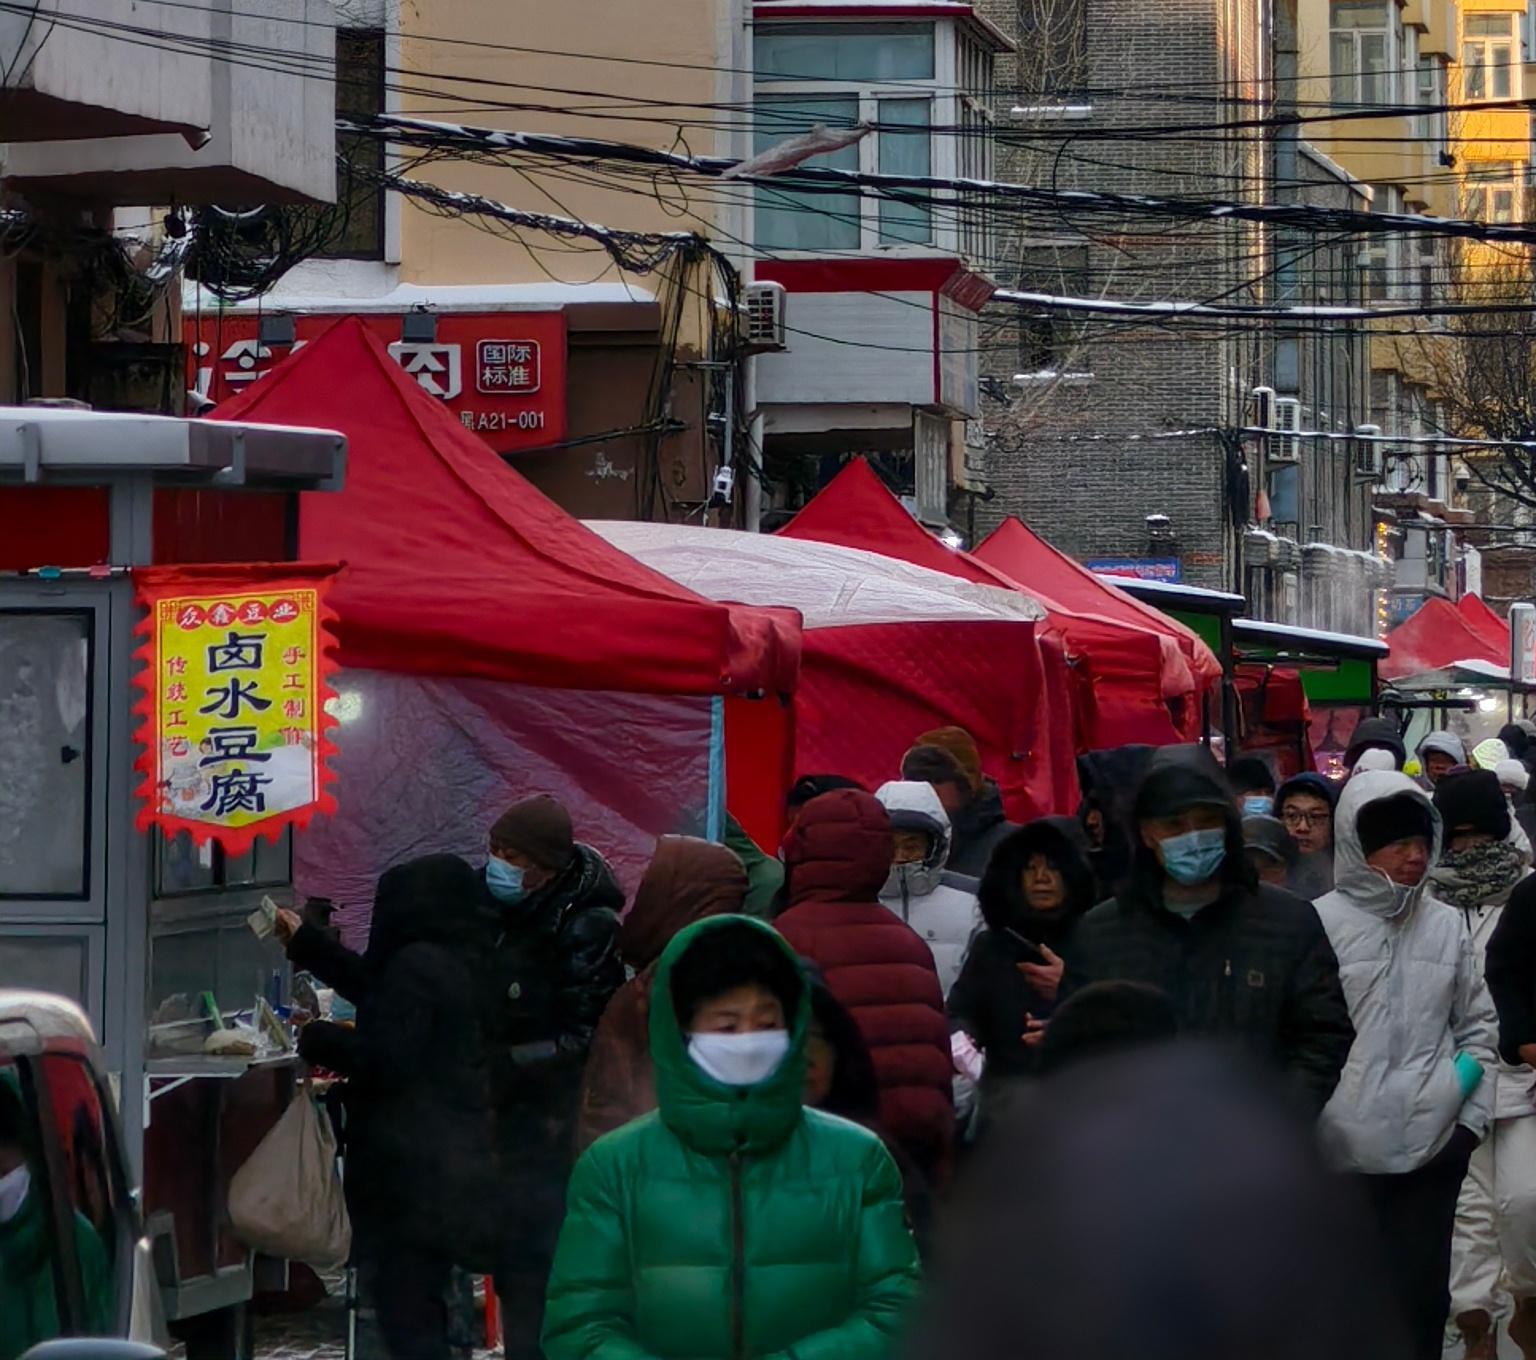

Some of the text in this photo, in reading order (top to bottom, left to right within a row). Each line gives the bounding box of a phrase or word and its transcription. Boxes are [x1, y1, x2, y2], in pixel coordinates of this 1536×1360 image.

[193, 339, 462, 400] 冷肉
[482, 365, 530, 387] 标准
[483, 344, 532, 364] 国际
[179, 601, 297, 628] 众鑫豆业
[166, 655, 189, 758] 传统工艺
[199, 631, 273, 817] 卤水豆腐
[280, 646, 306, 746] 手工制作
